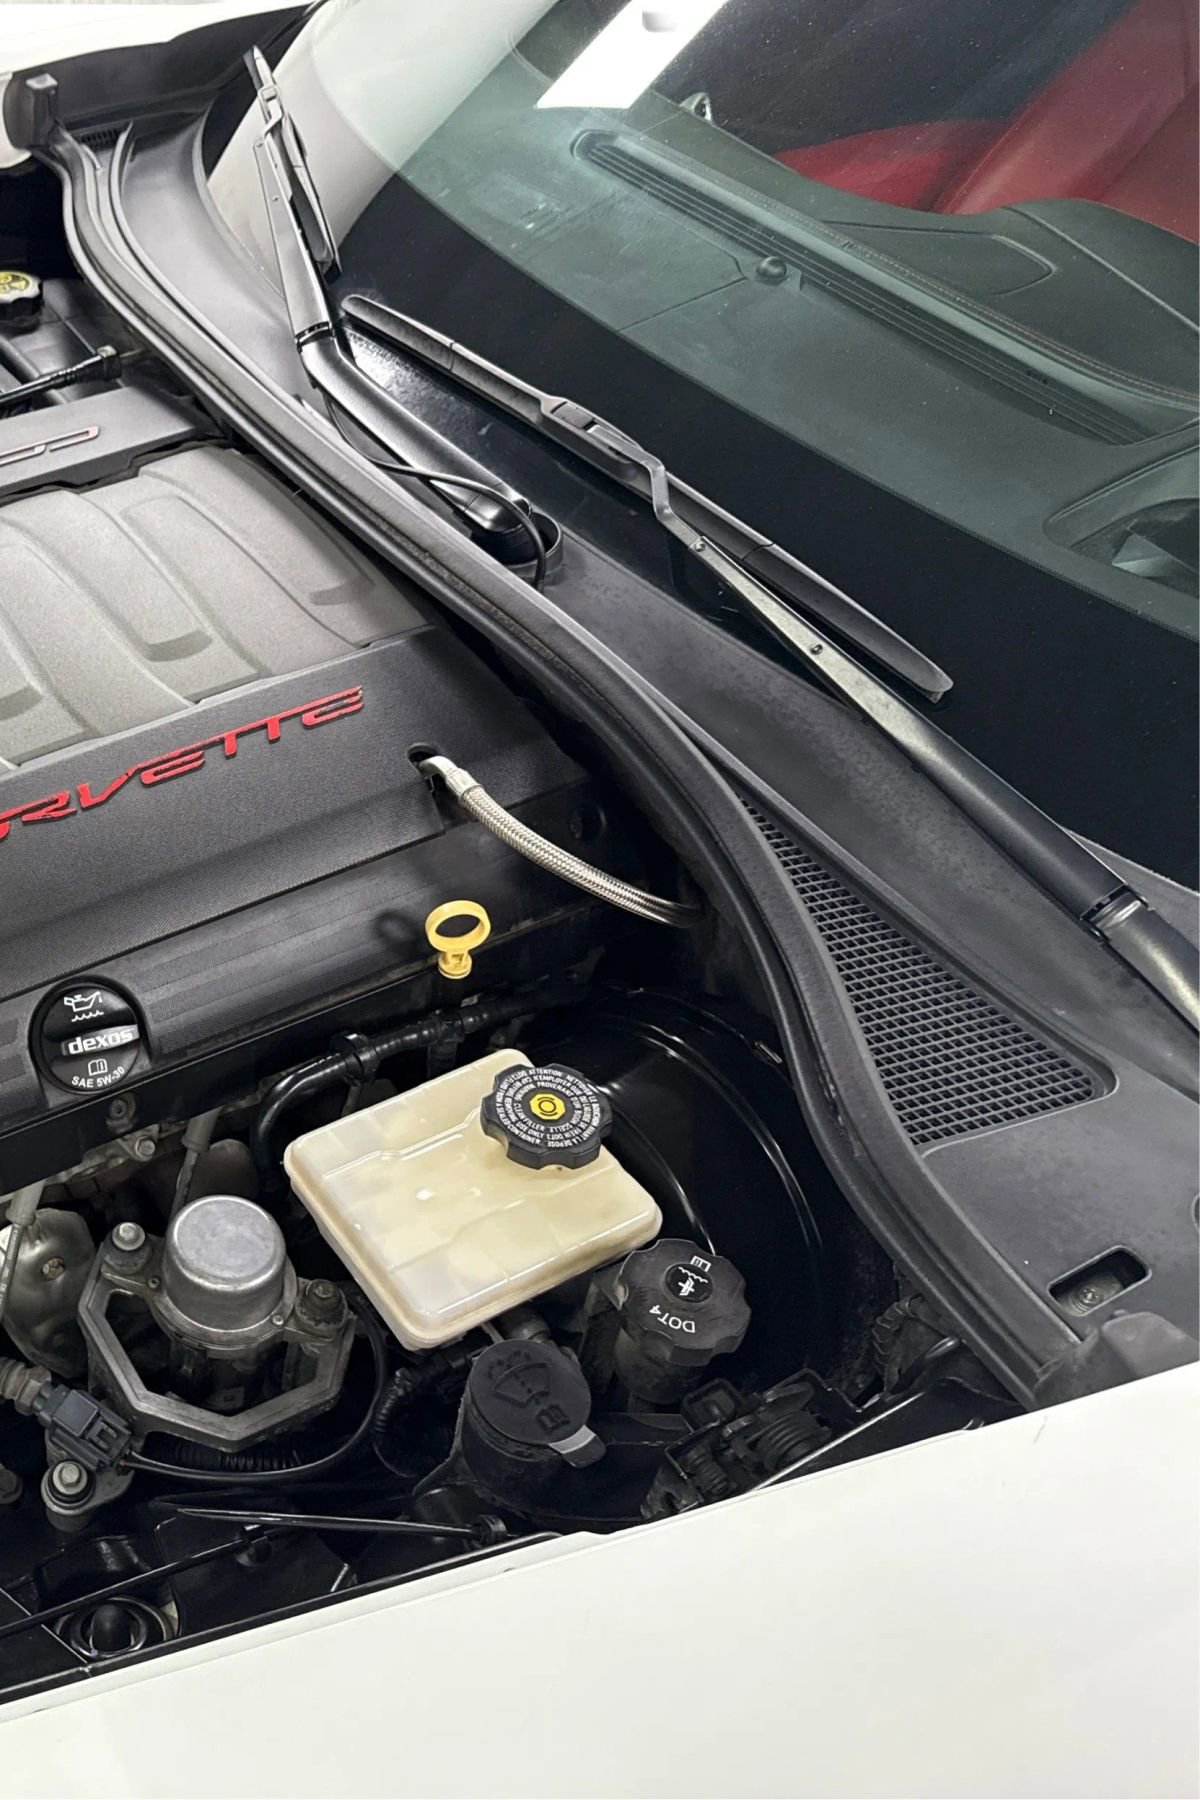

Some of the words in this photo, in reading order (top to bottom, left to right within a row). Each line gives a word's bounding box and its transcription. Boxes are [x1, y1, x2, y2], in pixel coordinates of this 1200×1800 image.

[68, 1028, 134, 1055] dexos
[71, 1076, 94, 1088] SAE
[97, 1066, 125, 1087] 5W-30
[529, 1068, 562, 1077] ATTENTION
[537, 1081, 574, 1097] PROVENANT
[497, 1107, 511, 1125] SEALED
[513, 1103, 527, 1119] CLEAN
[523, 1117, 545, 1131] FILLER
[515, 1121, 529, 1132] USE
[527, 1129, 545, 1138] ONLY
